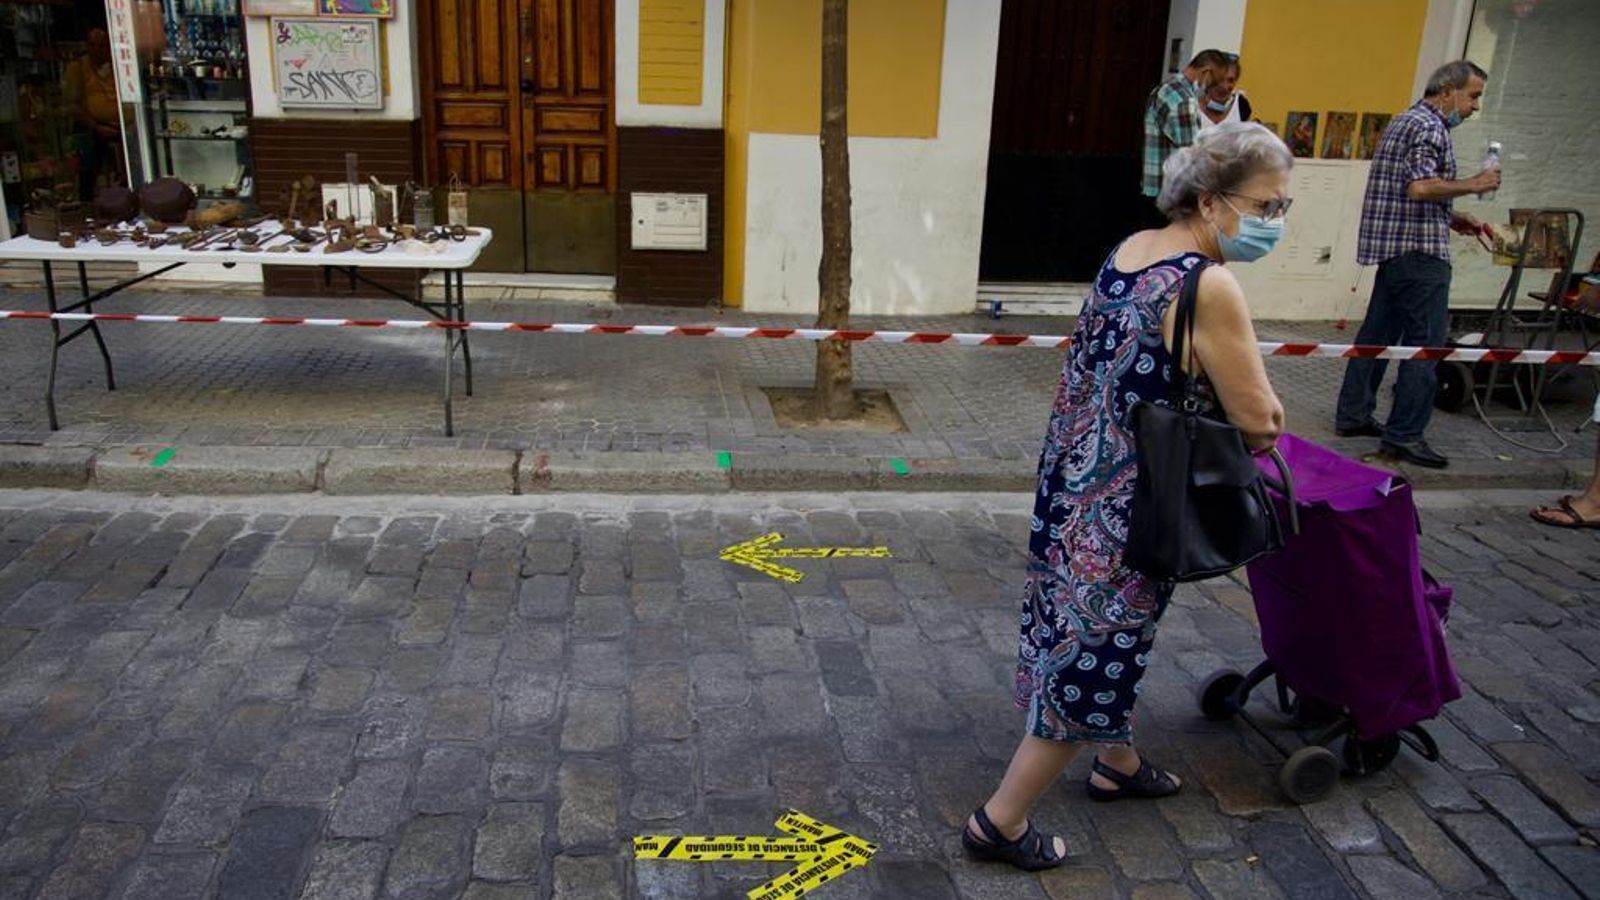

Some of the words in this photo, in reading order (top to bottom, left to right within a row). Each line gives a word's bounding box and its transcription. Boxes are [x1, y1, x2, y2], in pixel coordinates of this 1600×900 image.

[785, 818, 823, 836] MANTEN
[685, 843, 746, 852] SEGURIDAD
[749, 844, 760, 852] DE
[763, 844, 818, 853] DISTANCIA
[792, 857, 840, 886] DISTANCIA
[780, 882, 795, 894] DE
